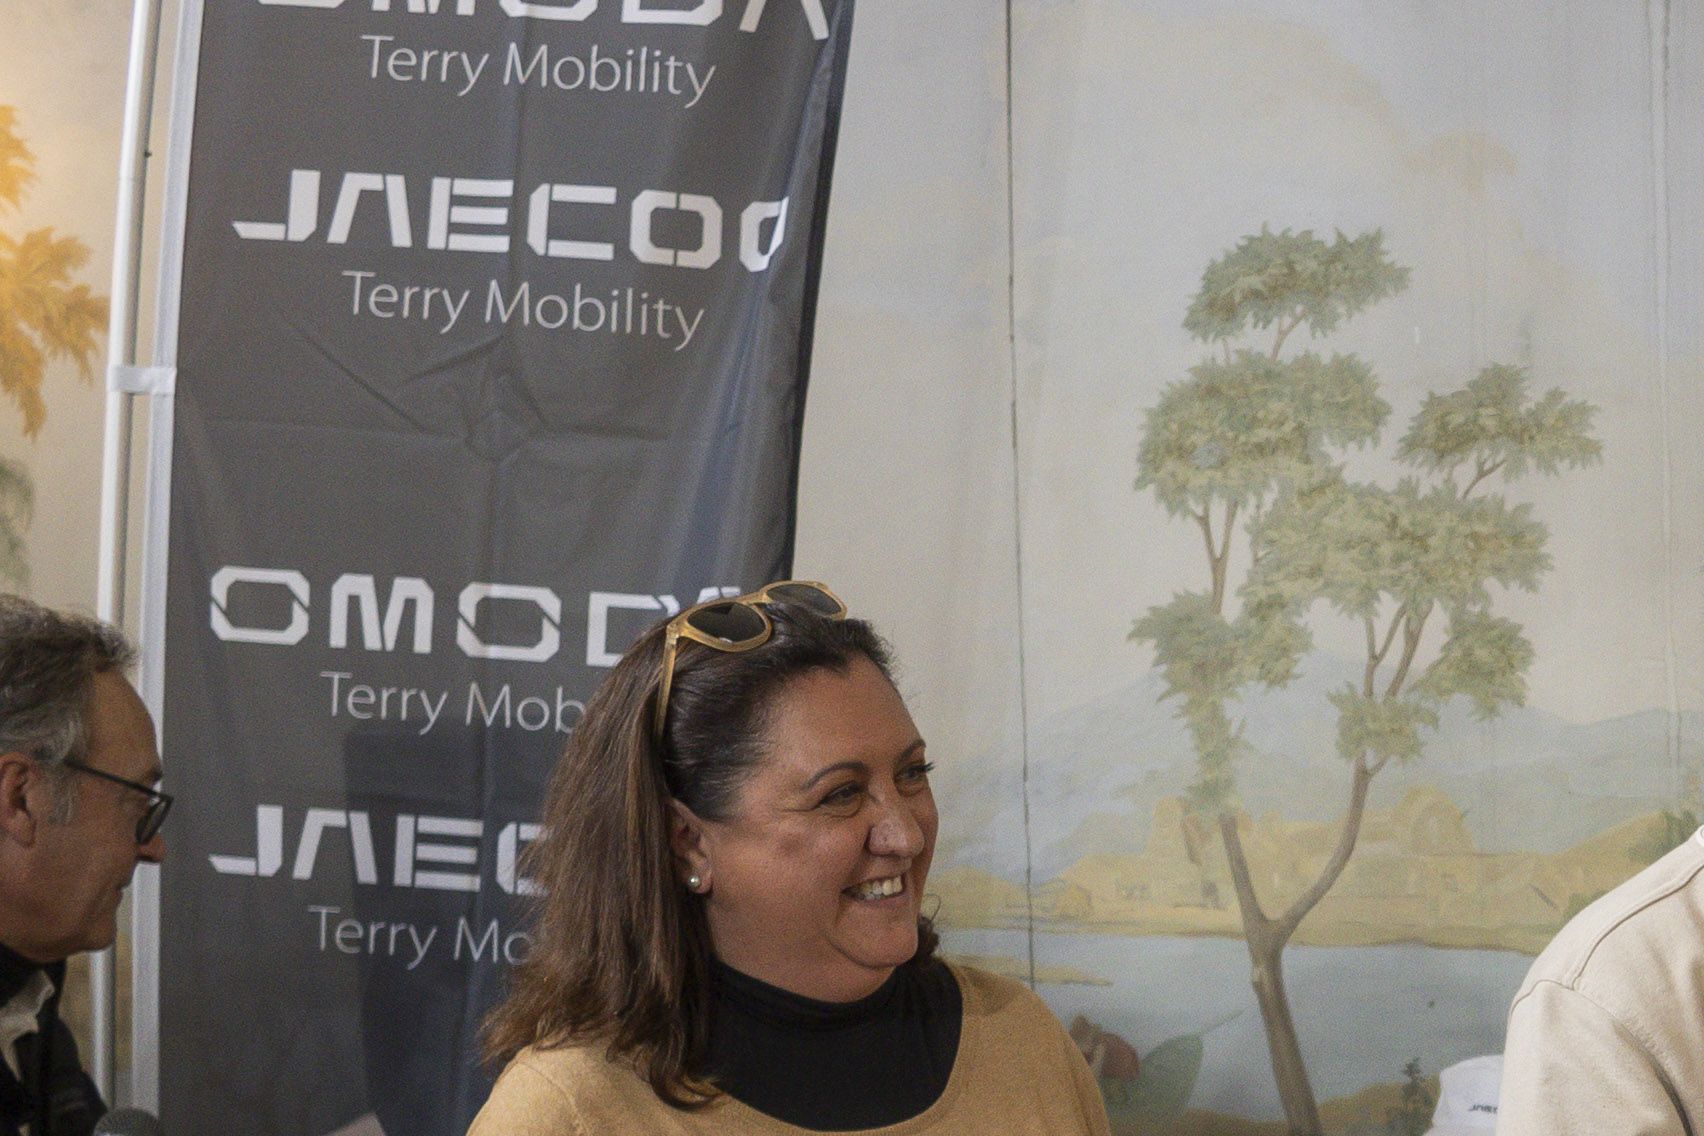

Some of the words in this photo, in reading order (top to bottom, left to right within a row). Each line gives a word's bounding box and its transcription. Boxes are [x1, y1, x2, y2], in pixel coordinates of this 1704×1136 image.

[361, 35, 489, 96] Terry
[503, 42, 716, 108] Mobility
[342, 270, 469, 334] Terry
[484, 280, 704, 351] Mobility
[210, 565, 740, 668] OMOD
[320, 671, 446, 735] Terry
[308, 905, 437, 970] Terry
